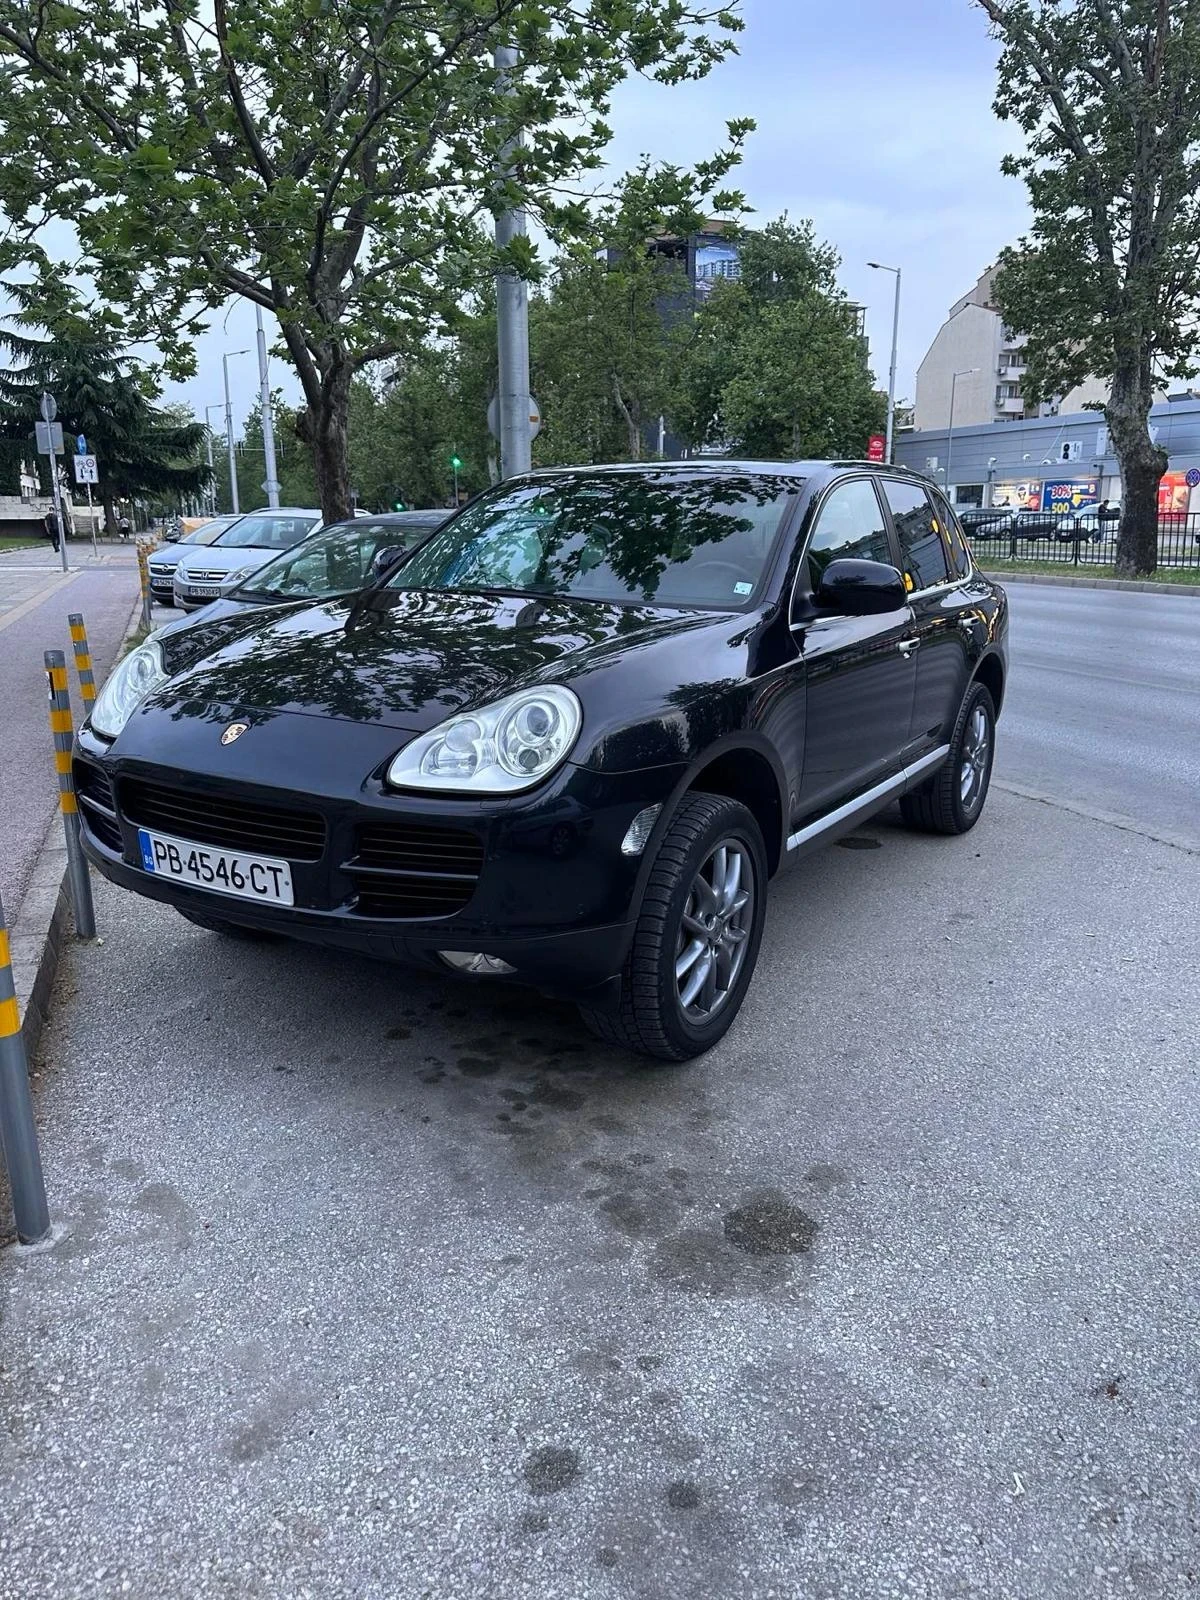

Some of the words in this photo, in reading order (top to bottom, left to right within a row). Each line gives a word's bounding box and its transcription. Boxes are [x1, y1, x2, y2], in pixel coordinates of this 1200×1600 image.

[1051, 485, 1072, 499] 30%
[1051, 502, 1070, 514] 500
[143, 854, 154, 866] BG
